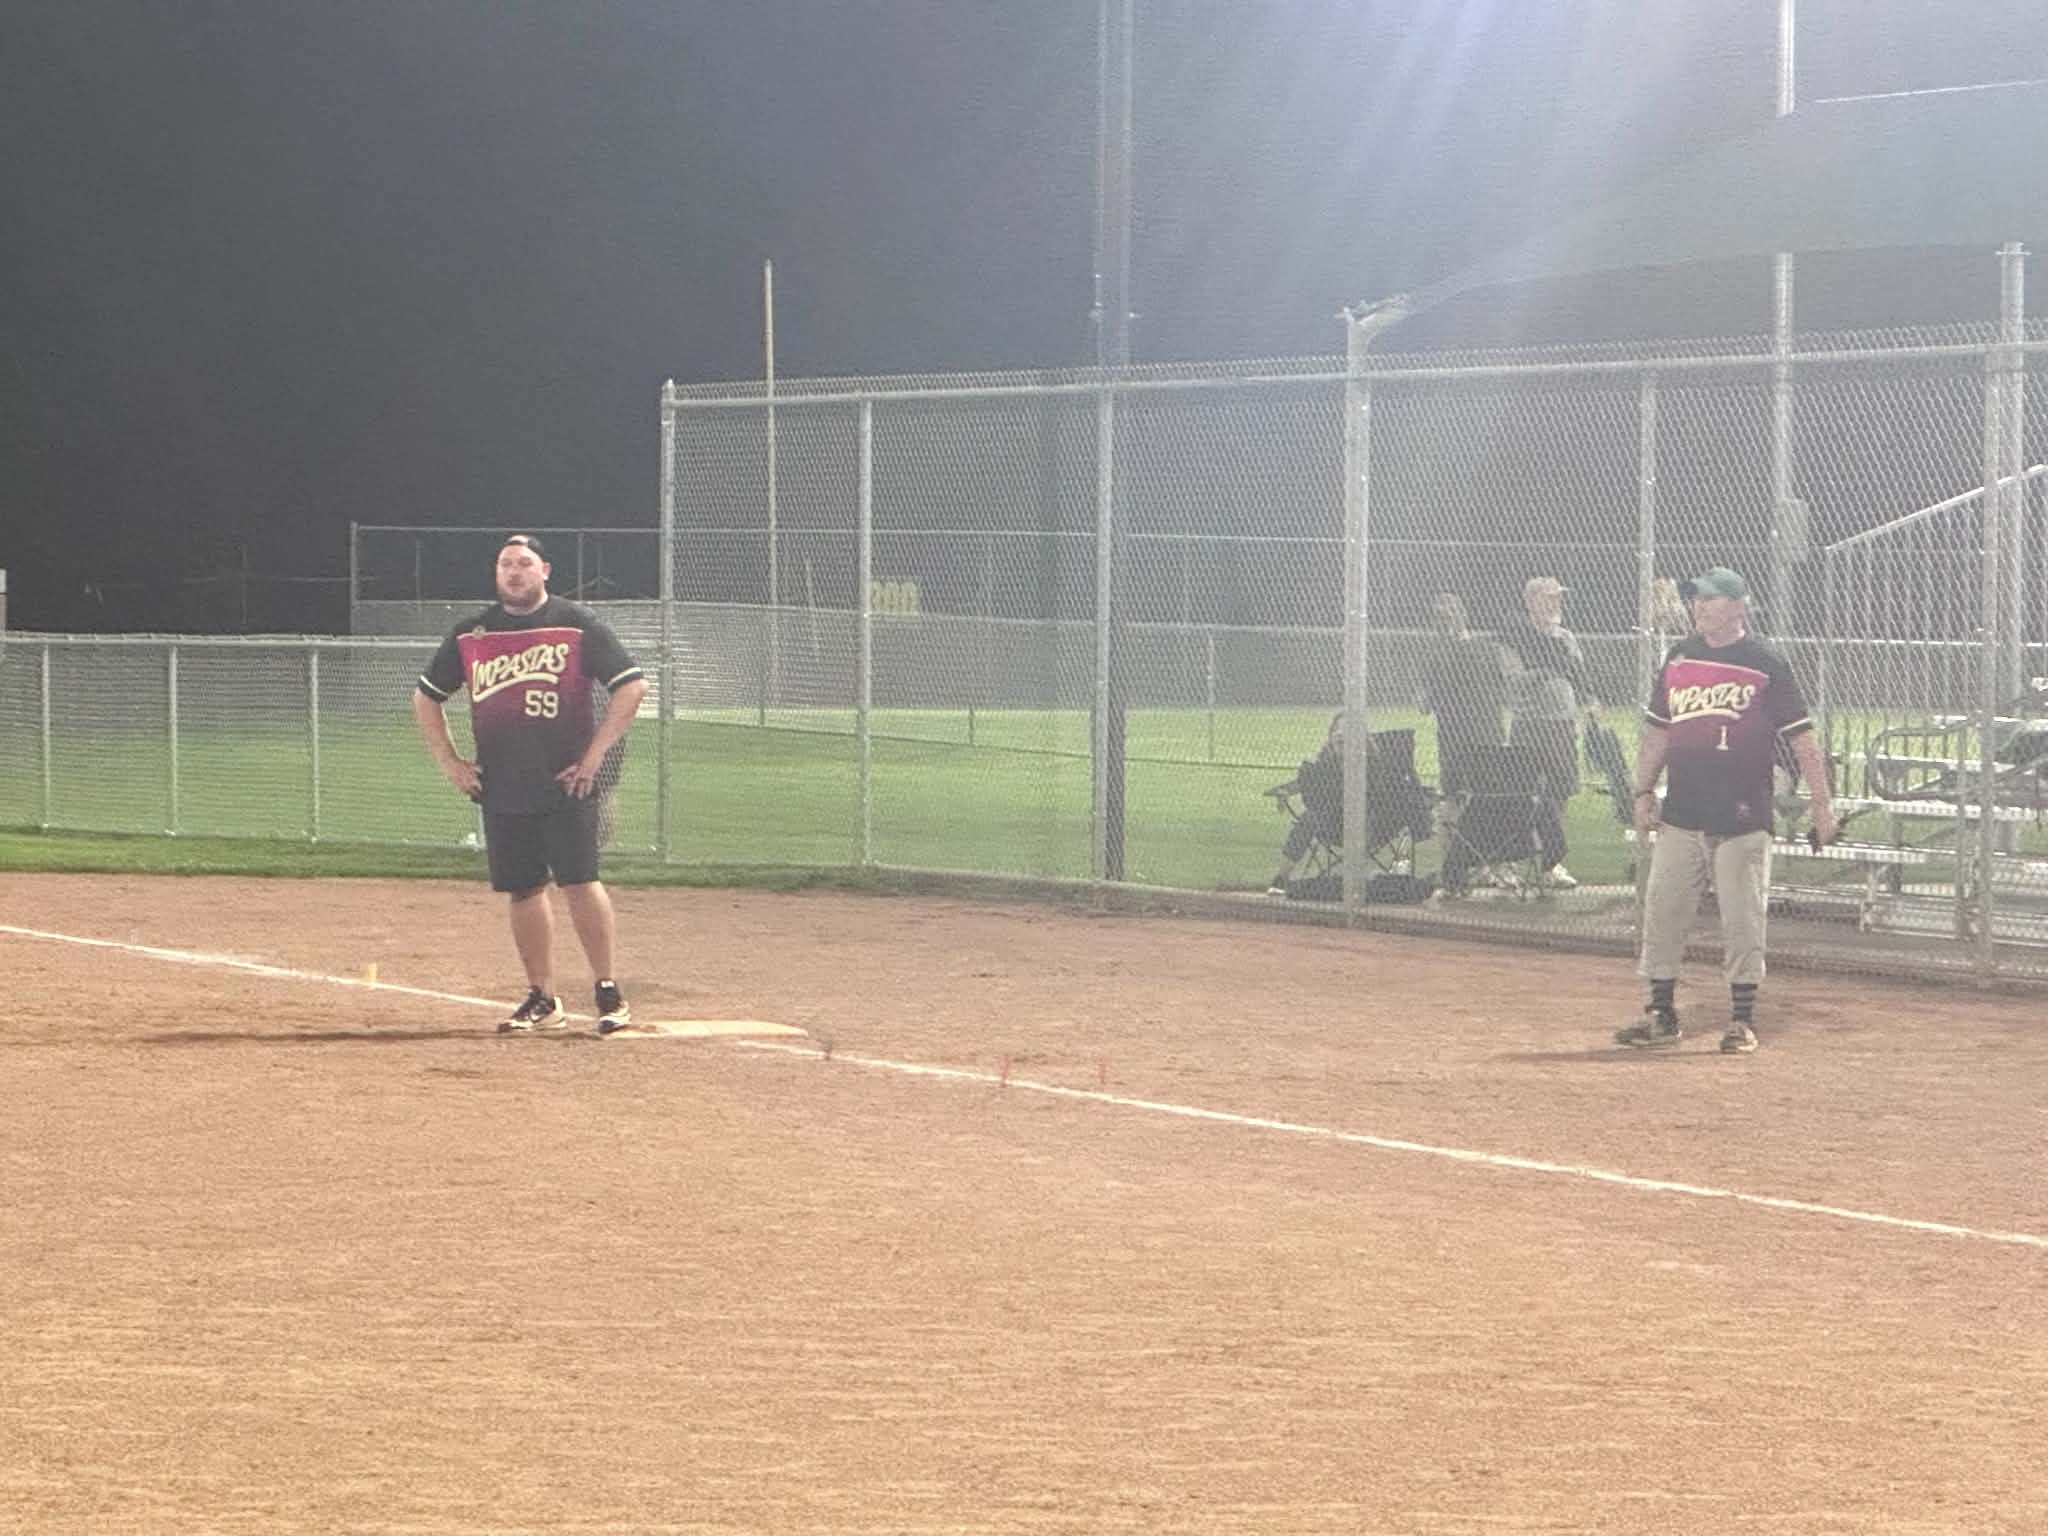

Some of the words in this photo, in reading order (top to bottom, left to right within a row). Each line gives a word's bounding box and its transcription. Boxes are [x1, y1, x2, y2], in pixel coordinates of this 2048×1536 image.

[472, 643, 569, 701] IMPASTAS
[525, 690, 559, 719] 59
[1716, 725, 1729, 751] 1
